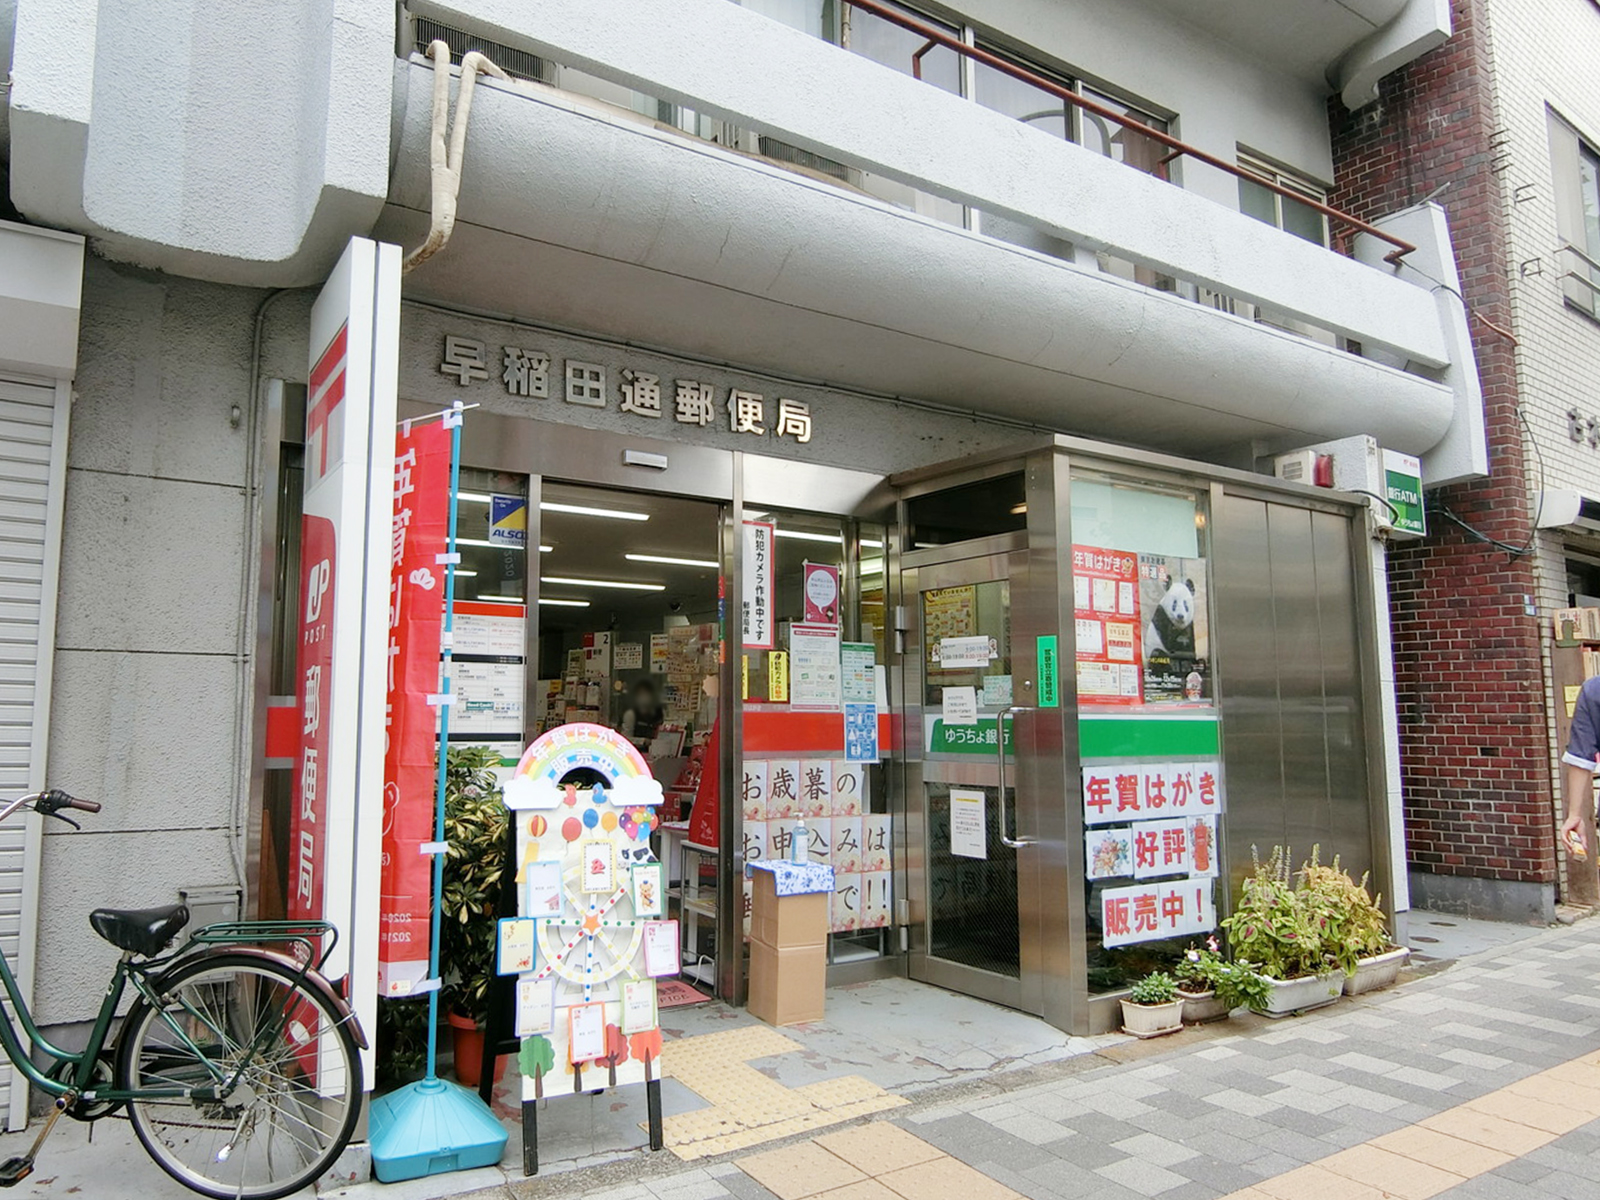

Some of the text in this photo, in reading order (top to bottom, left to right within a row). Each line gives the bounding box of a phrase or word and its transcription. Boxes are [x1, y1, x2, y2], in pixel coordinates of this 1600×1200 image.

[439, 334, 812, 443] 早稲田通郵便局
[492, 528, 525, 539] ALSO
[1074, 551, 1121, 573] 年賀はがき
[755, 528, 765, 641] 防犯カメラ作動中です
[304, 624, 326, 646] POST
[531, 726, 631, 762] 年賀はがき
[945, 728, 1010, 745] ゆうちょ銀行
[550, 748, 615, 775] 販売中
[297, 664, 321, 910] 郵便局
[743, 767, 857, 801] お歳暮の
[1085, 771, 1215, 813] 年賀はがき
[743, 826, 886, 861] お申込みは
[1135, 828, 1187, 869] 好評
[1105, 888, 1203, 937] 販売中!
[660, 993, 690, 1004] FICE
